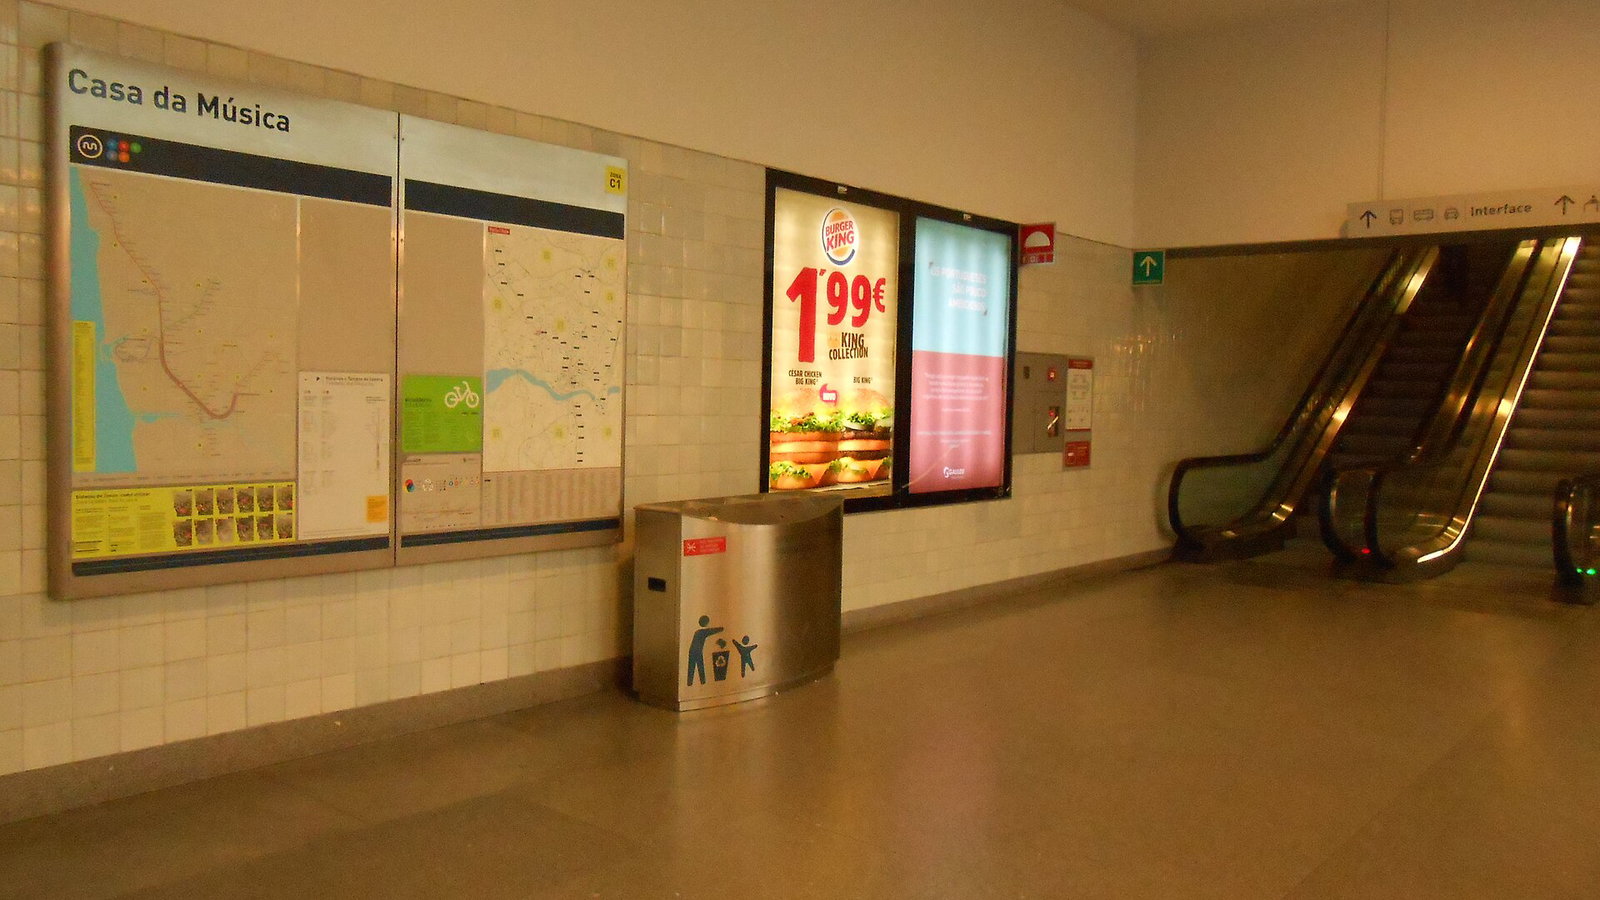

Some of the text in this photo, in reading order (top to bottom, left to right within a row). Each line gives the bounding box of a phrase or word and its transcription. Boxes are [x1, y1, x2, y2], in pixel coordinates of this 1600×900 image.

[68, 68, 291, 132] Casa da Música
[610, 178, 620, 189] C1
[1471, 203, 1533, 217] Interface
[826, 221, 854, 237] BURGER
[826, 230, 855, 251] KING
[841, 332, 865, 348] KING
[829, 347, 869, 360] COLLECTION
[804, 370, 822, 378] CHICKEN
[853, 376, 861, 384] BIG
